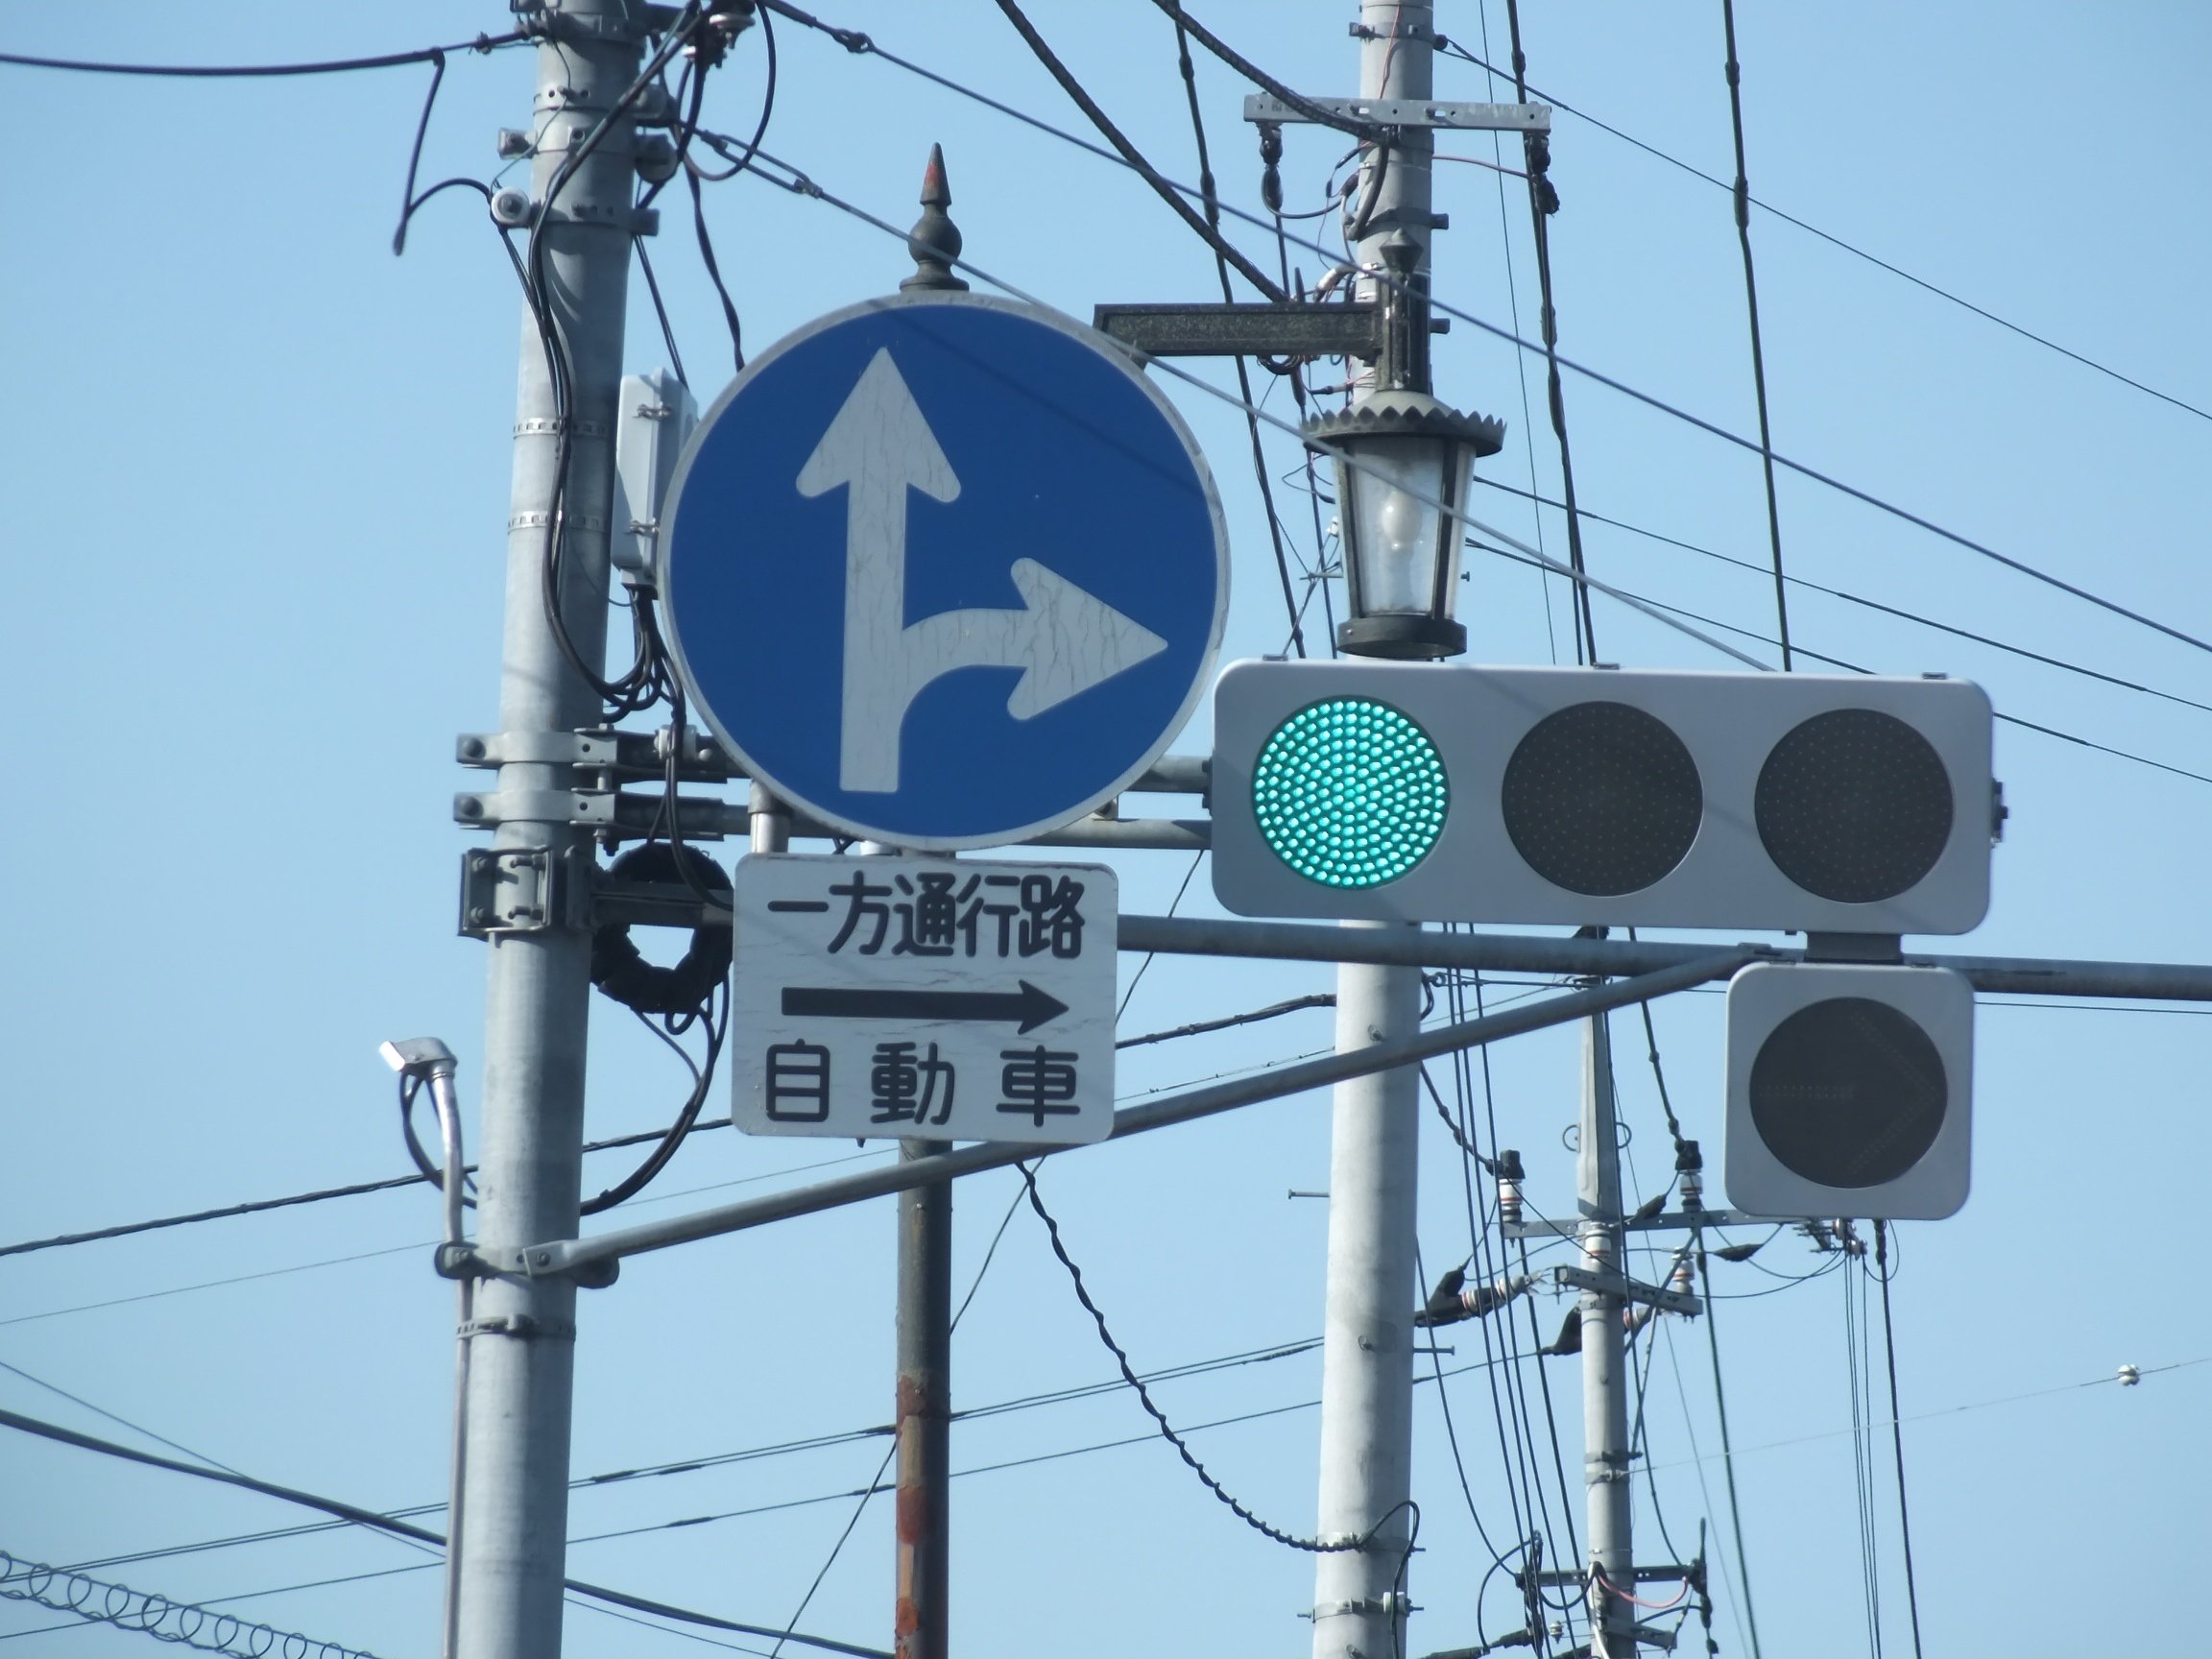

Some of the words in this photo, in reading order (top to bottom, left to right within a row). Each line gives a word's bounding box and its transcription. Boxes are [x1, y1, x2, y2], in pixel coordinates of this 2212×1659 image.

[767, 870, 1085, 959] 一方通行路
[766, 1038, 1081, 1128] 自動車
